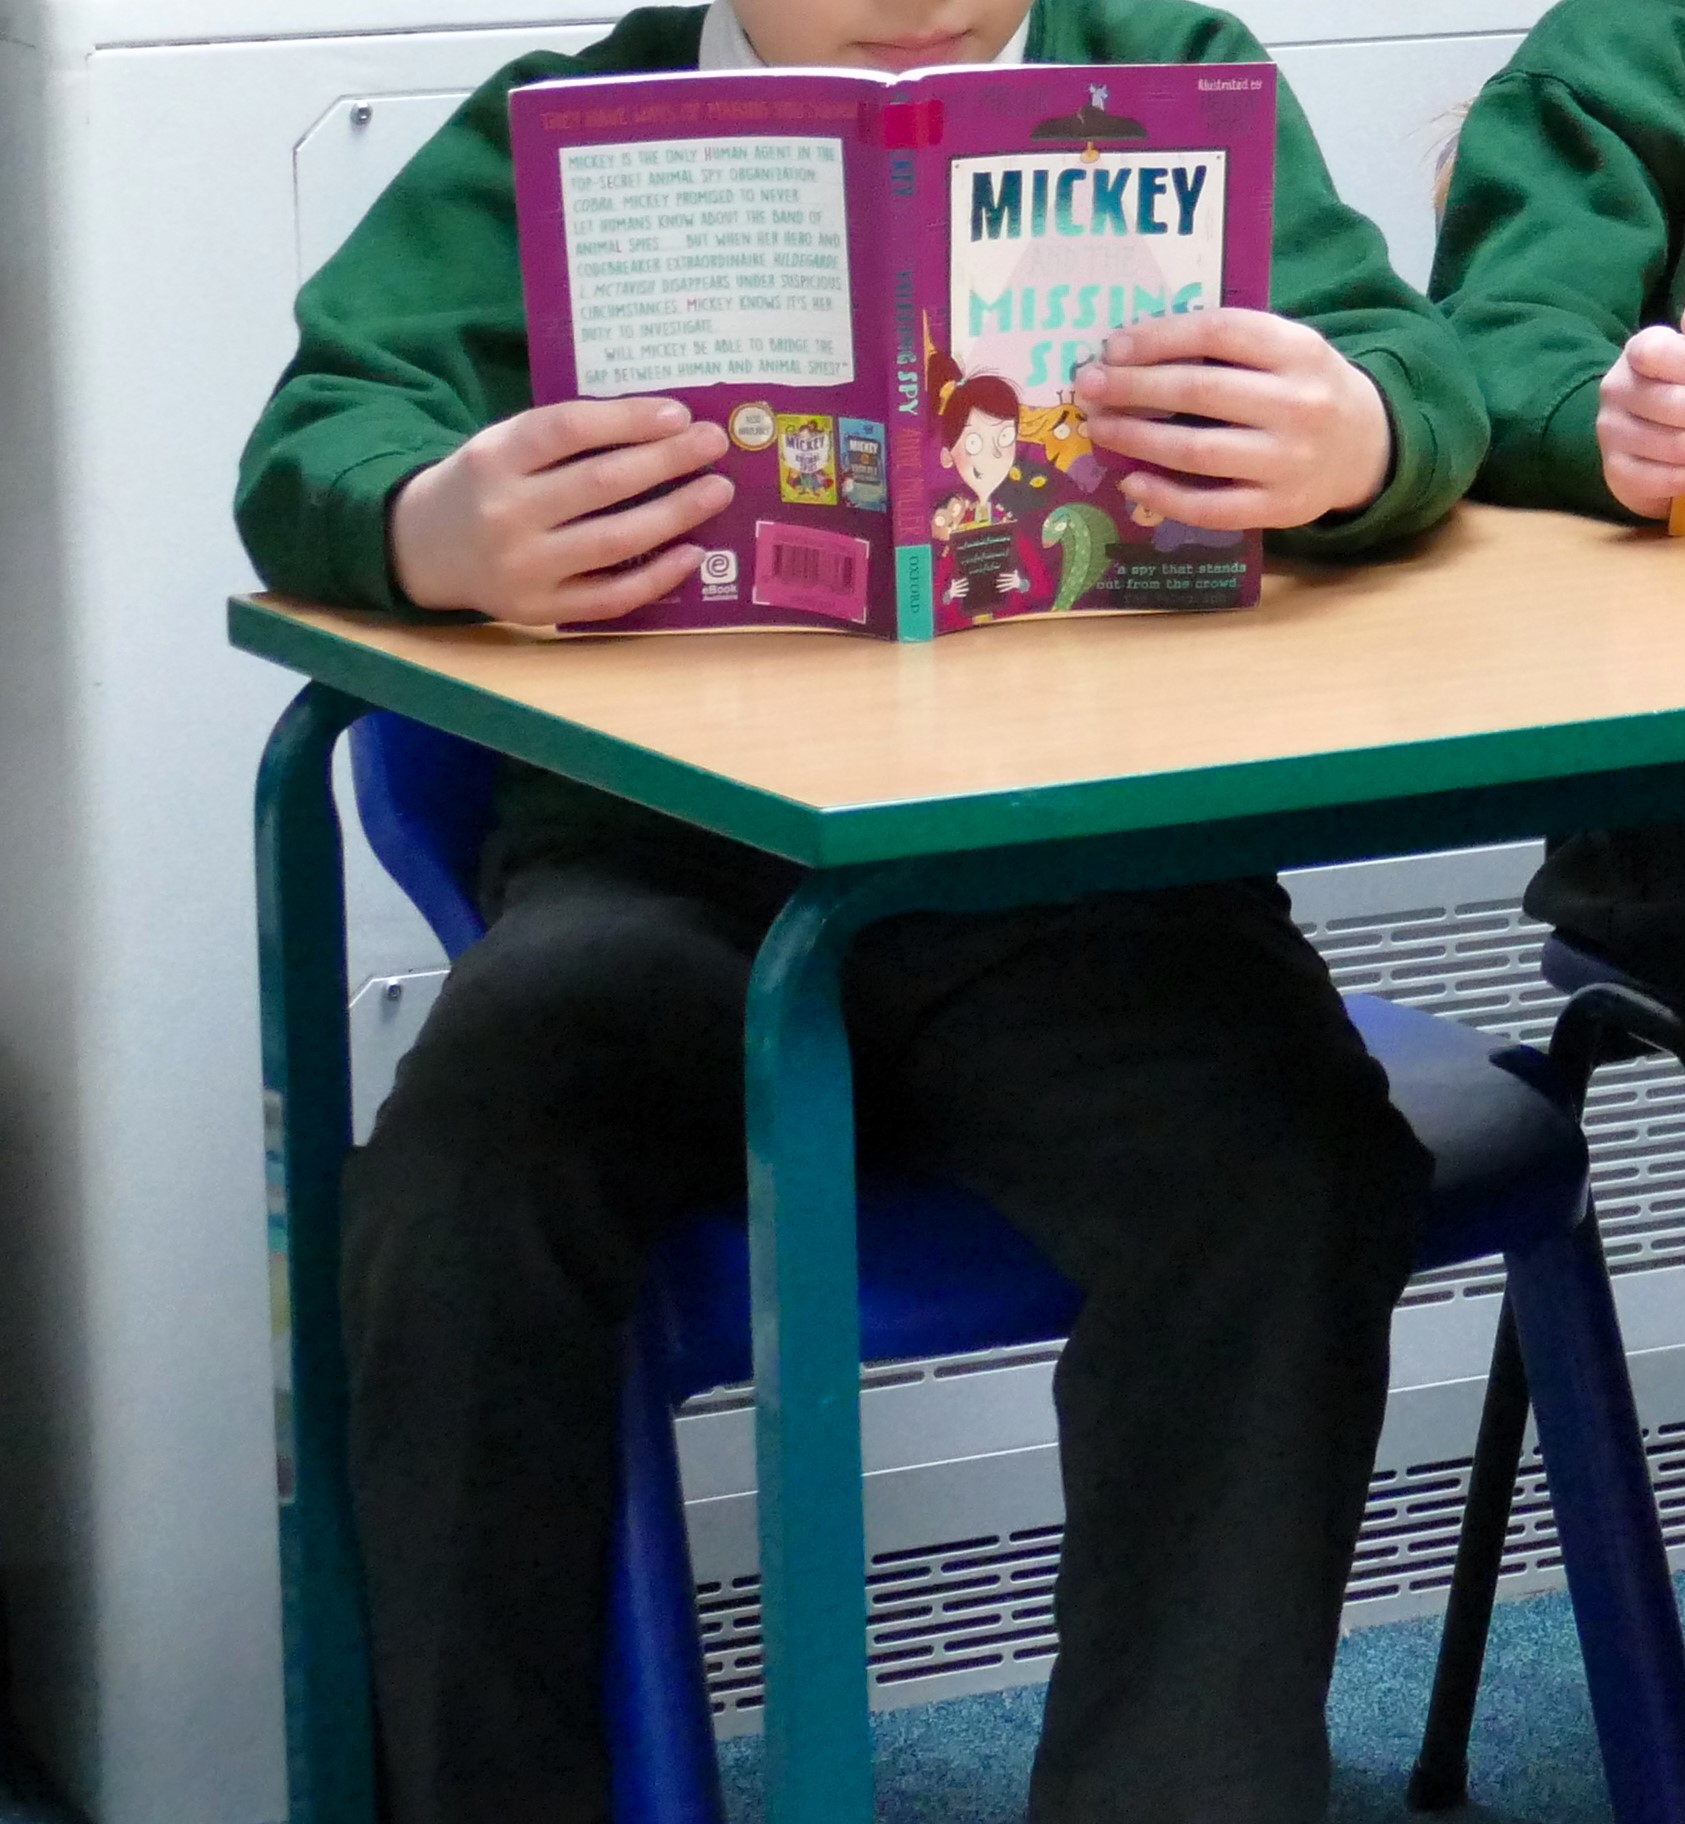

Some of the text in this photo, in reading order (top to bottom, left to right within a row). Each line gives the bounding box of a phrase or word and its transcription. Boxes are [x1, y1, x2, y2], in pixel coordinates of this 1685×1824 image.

[623, 194, 669, 210] MICKEY
[741, 189, 756, 203] TO
[760, 188, 799, 202] NEVER
[971, 165, 1207, 242] MICKEY
[1132, 562, 1247, 577] spy that stands
[702, 584, 737, 594] eBook
[910, 556, 920, 614] OXFORD
[1096, 577, 1237, 590] out from the crowd
